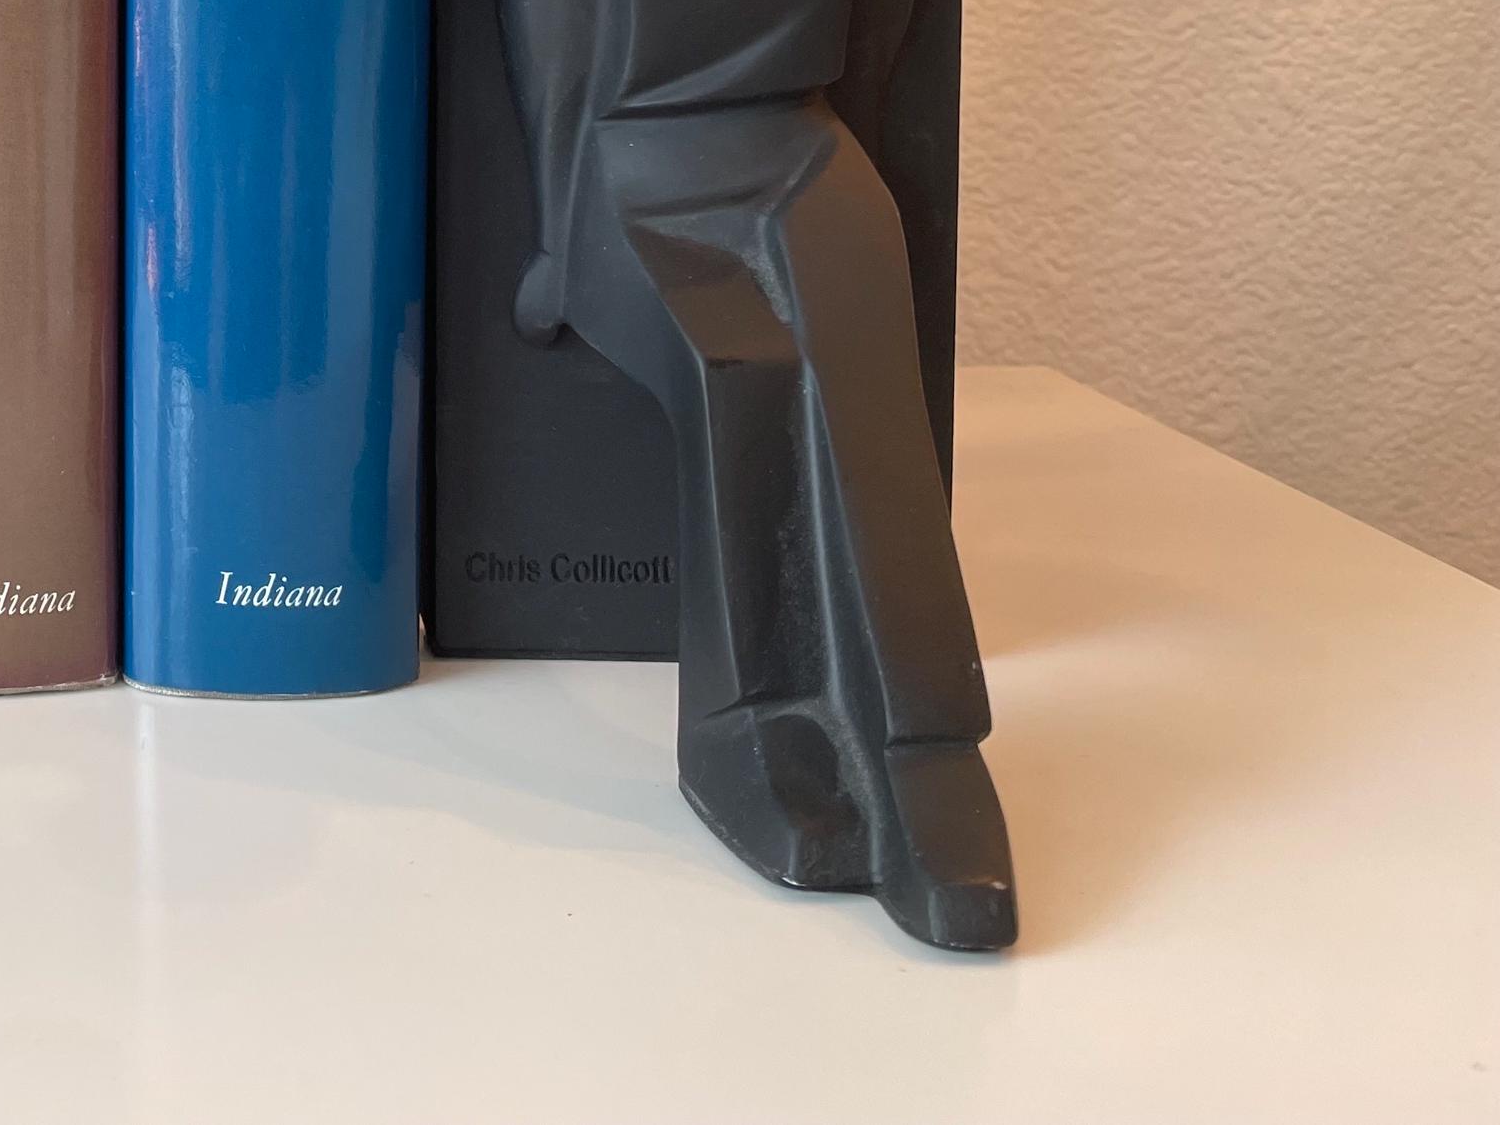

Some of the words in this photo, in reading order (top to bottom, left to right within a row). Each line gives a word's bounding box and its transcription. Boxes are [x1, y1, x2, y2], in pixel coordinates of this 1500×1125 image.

[466, 552, 541, 582] Chris
[550, 553, 671, 584] Collicott
[215, 571, 343, 609] Indiana
